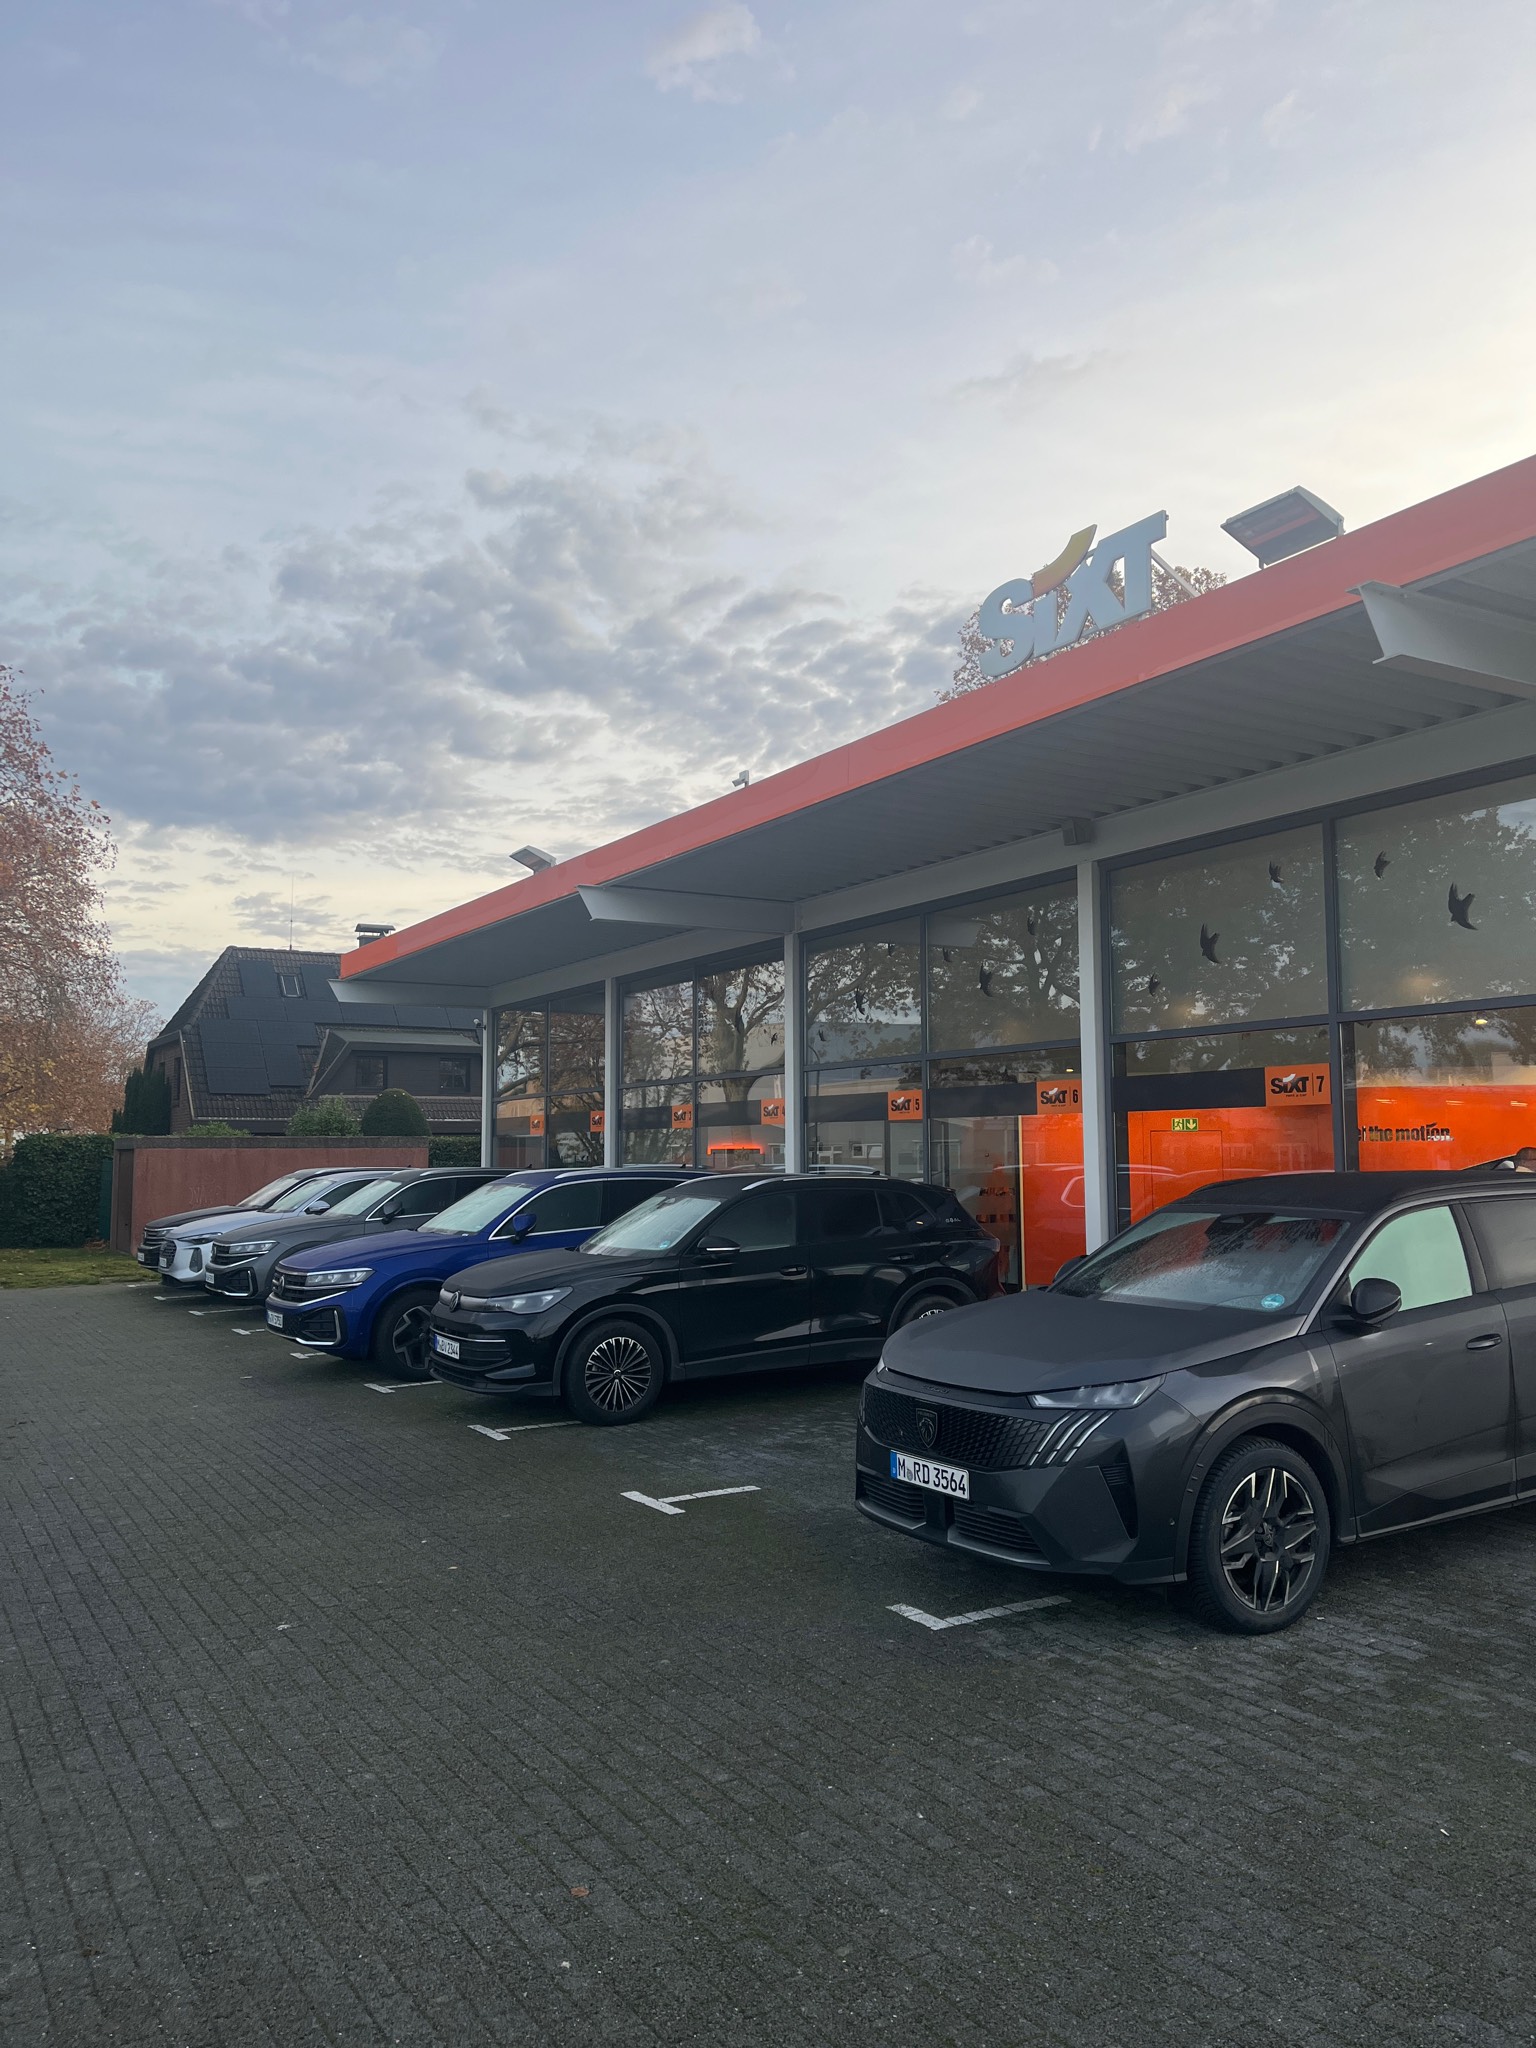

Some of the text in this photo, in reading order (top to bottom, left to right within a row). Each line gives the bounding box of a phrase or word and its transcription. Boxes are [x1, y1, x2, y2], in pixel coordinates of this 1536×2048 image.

[979, 510, 1167, 677] SIXT
[1270, 1073, 1324, 1094] SIXT 7
[891, 1096, 920, 1112] SIXT 5
[1040, 1087, 1078, 1104] SIXT 6
[1368, 1125, 1393, 1141] the
[898, 1457, 966, 1495] M RD 3564
